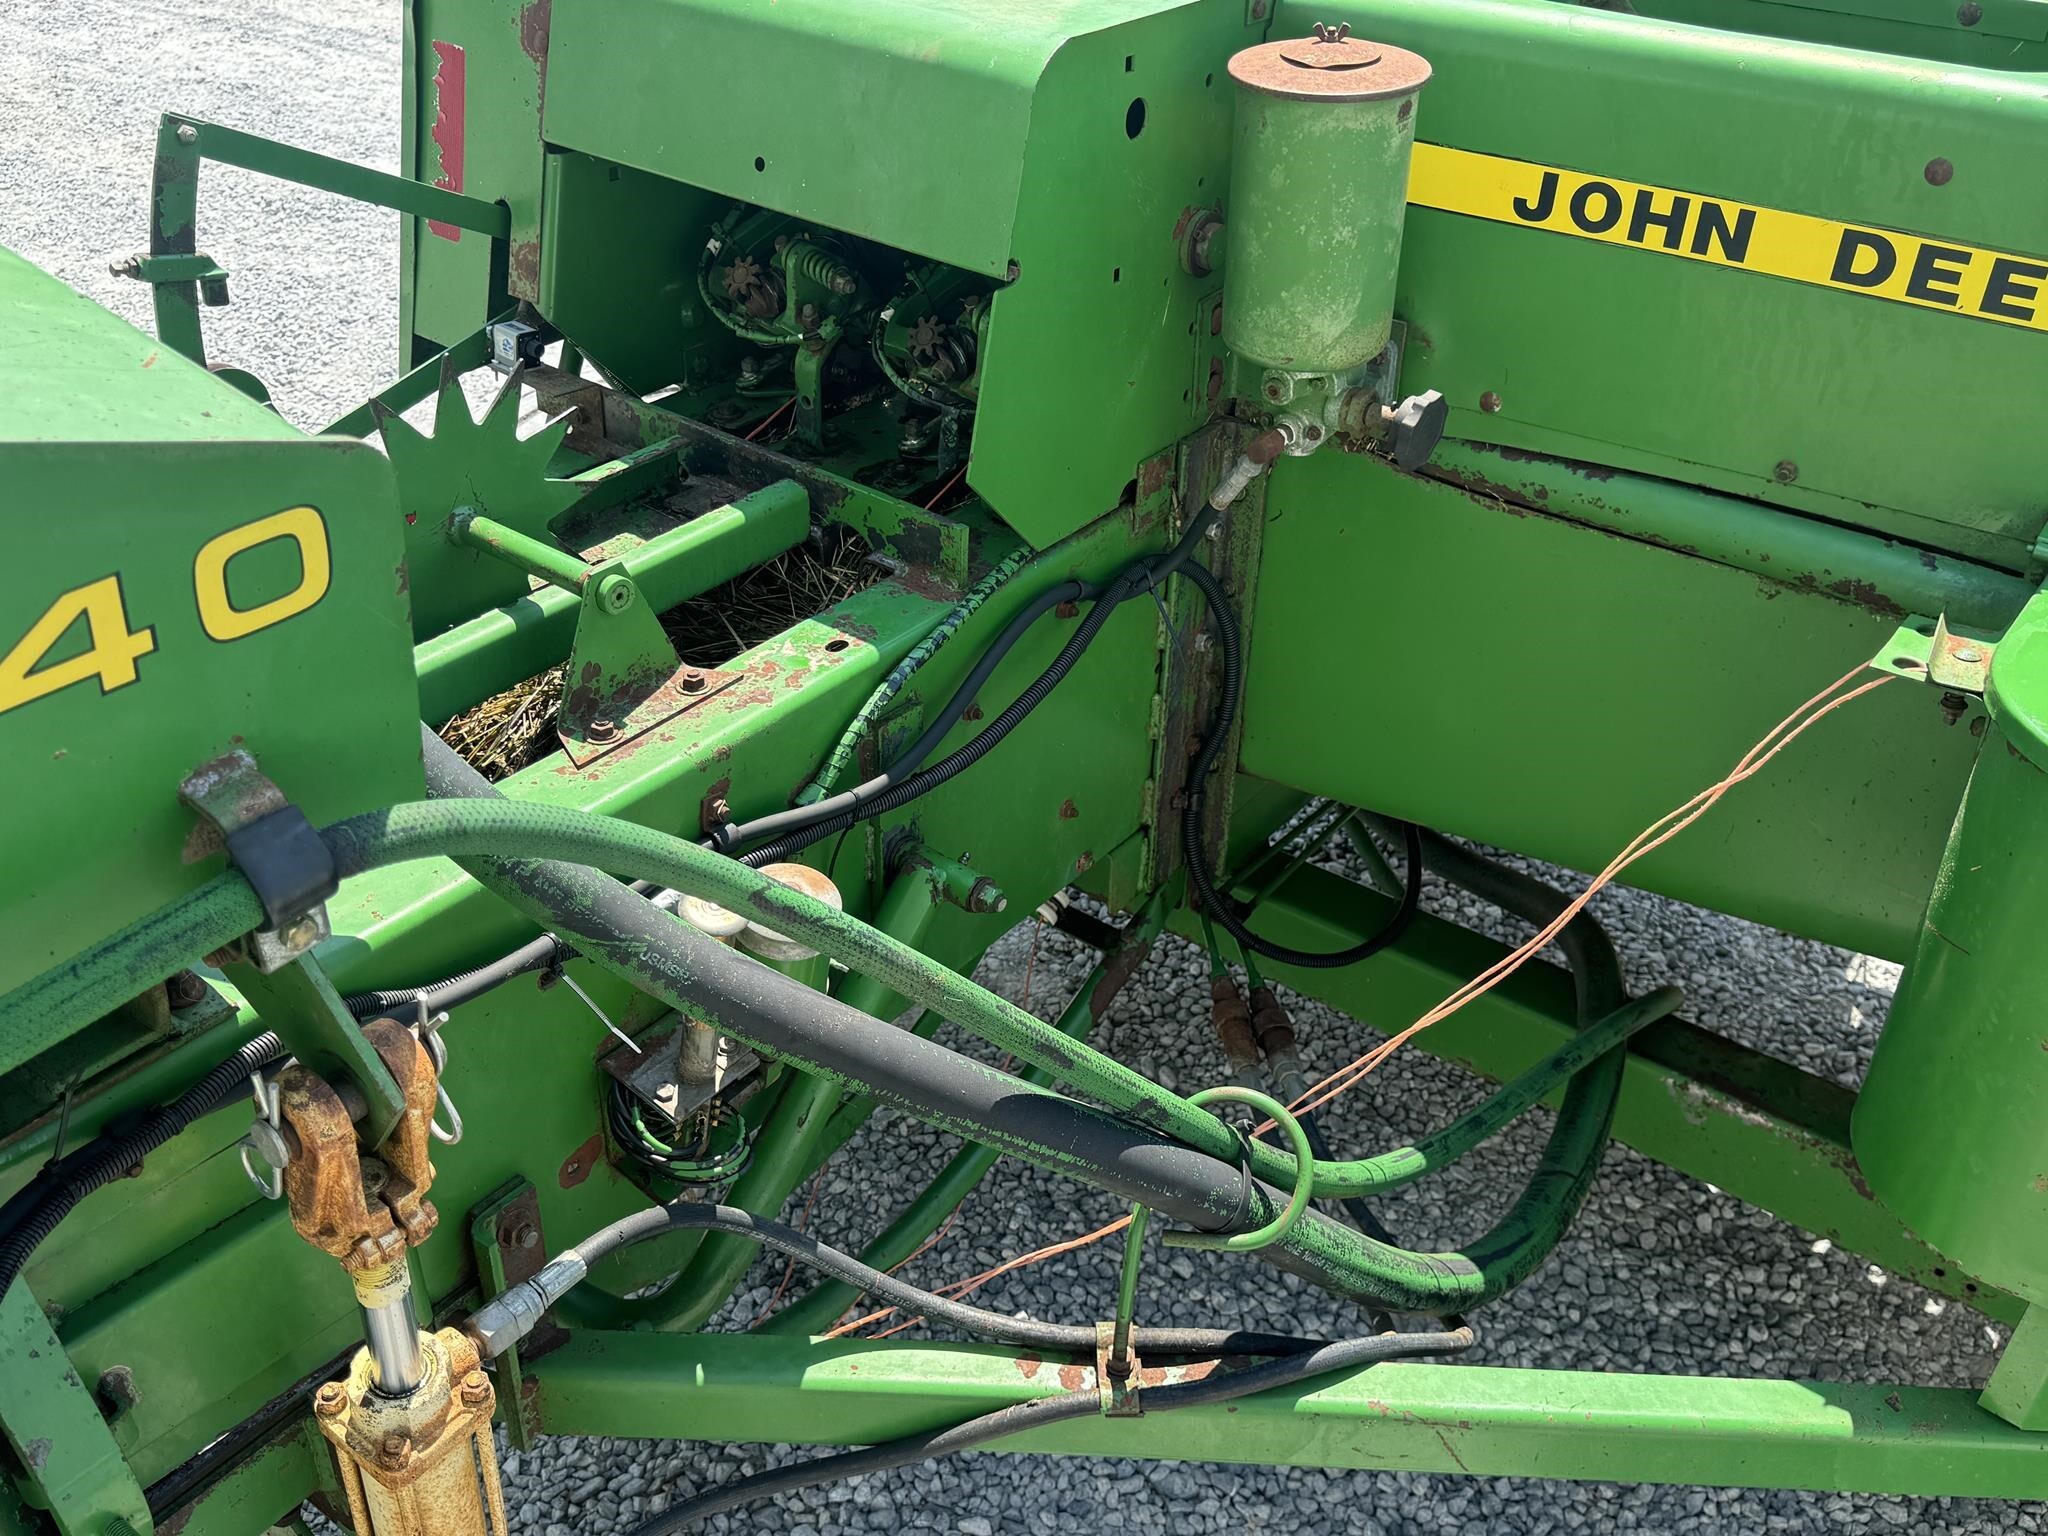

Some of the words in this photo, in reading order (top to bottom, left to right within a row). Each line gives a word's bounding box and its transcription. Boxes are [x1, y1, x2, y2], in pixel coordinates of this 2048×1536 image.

[1513, 171, 1757, 263] JOHN
[1830, 228, 2048, 322] DEE
[0, 503, 332, 715] 40
